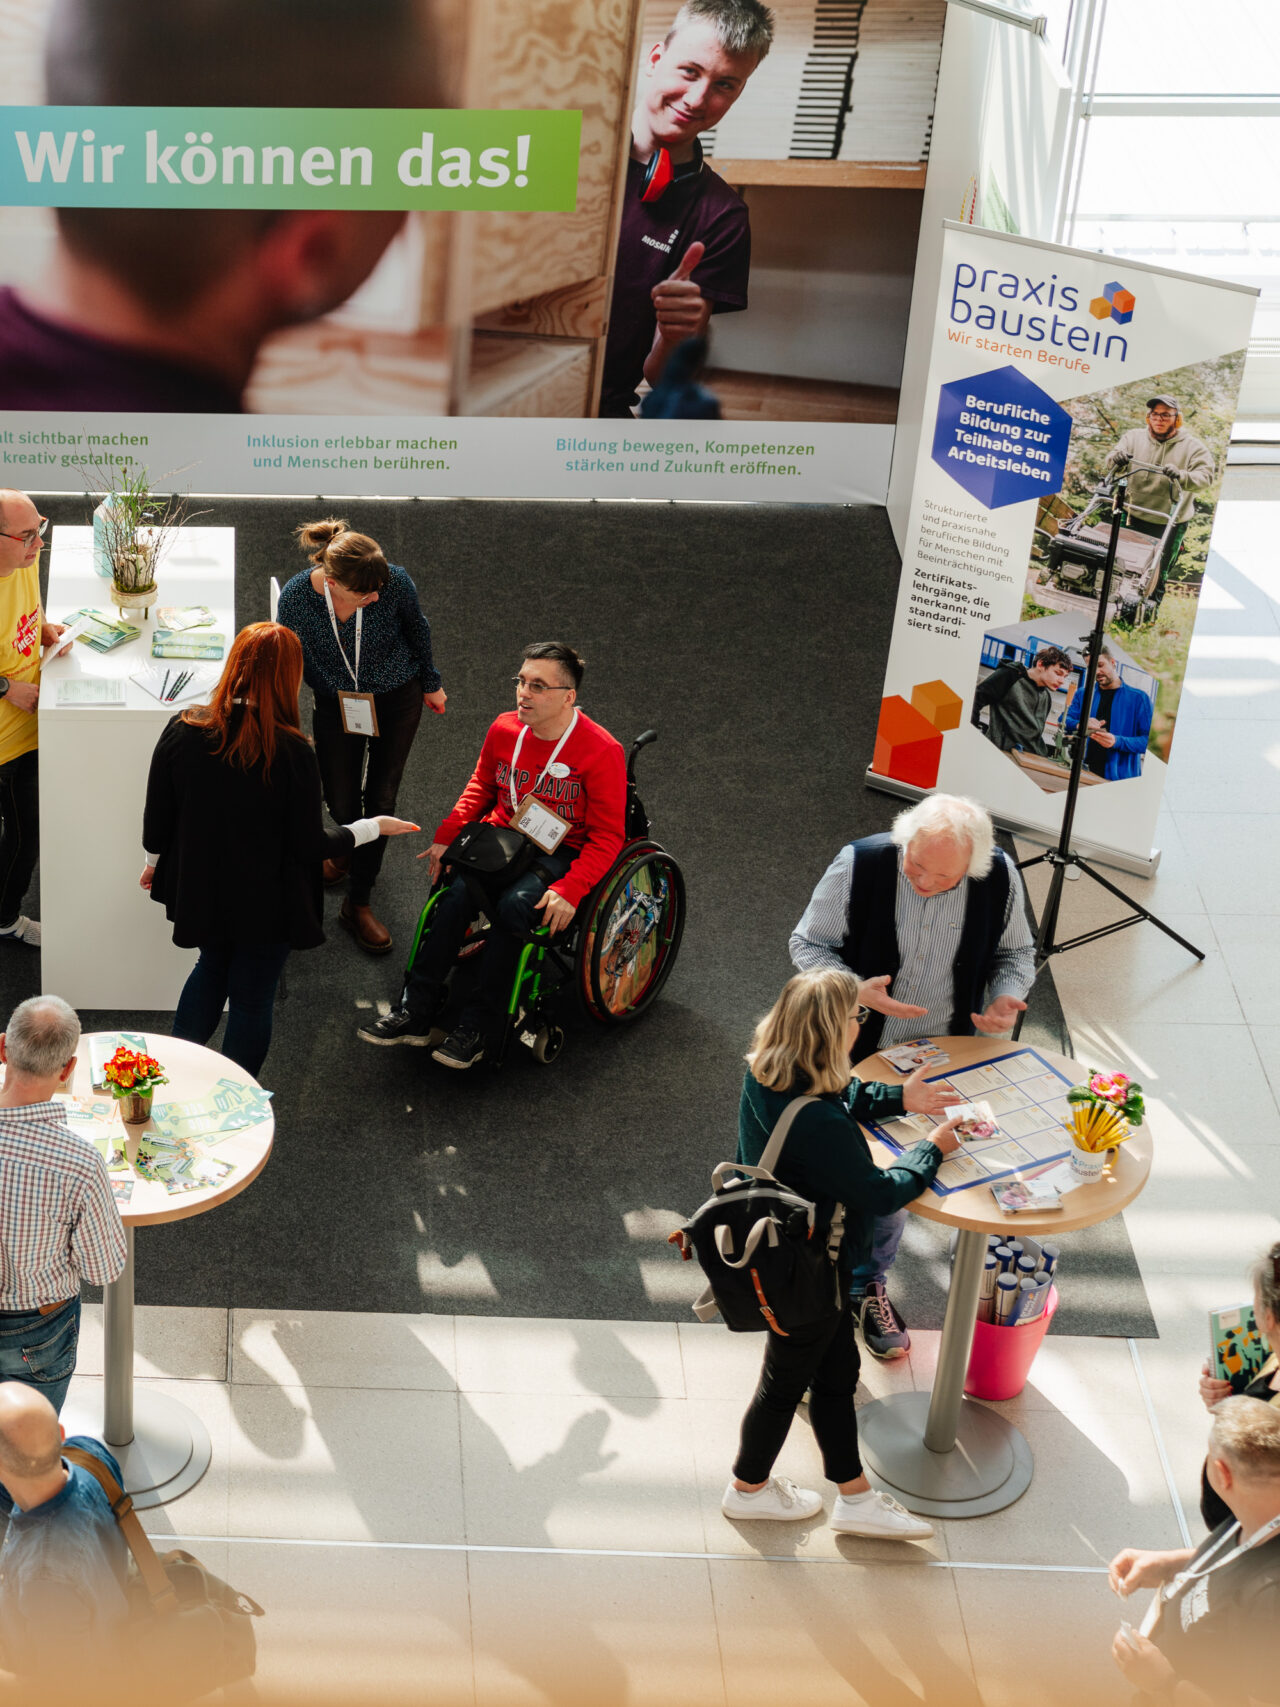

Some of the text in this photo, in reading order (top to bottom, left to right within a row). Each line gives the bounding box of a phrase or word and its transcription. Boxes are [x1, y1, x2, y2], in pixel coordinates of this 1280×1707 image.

[15, 129, 532, 188] Wir können das!
[642, 234, 672, 254] MOSAIK
[952, 263, 1080, 312] praxis
[950, 287, 1129, 362] baustein
[947, 328, 1091, 374] Wir starten Berufe
[965, 394, 1051, 426] Berufliche
[18, 431, 82, 445] sichtbar
[88, 432, 148, 446] machen
[959, 410, 1052, 444] Bildung zur
[246, 434, 458, 450] Inklusion erlebbar machen
[556, 438, 816, 457] Bildung bewegen, Kompetenzen
[954, 428, 1050, 464] Teilhabe am
[4, 450, 57, 464] kreativ
[60, 452, 139, 468] gestalten.
[253, 455, 450, 470] und Menschen berühren.
[565, 458, 802, 476] stärken und Zukunft eröffnen.
[947, 446, 1052, 482] Arbeitsleben
[922, 512, 997, 538] und praxisnahe
[924, 499, 988, 524] Strukturierte
[918, 536, 1004, 568] für Menschen mit
[920, 524, 1010, 558] berufliche Bildung
[914, 567, 978, 591] Zertifikats-
[916, 550, 1015, 584] Beeinträchtigungen.
[910, 593, 992, 622] anerkannt und
[912, 580, 990, 609] lehrgänge, die
[907, 617, 962, 640] siert sind.
[908, 606, 966, 627] standardi-
[496, 761, 580, 802] CAMP DAVID
